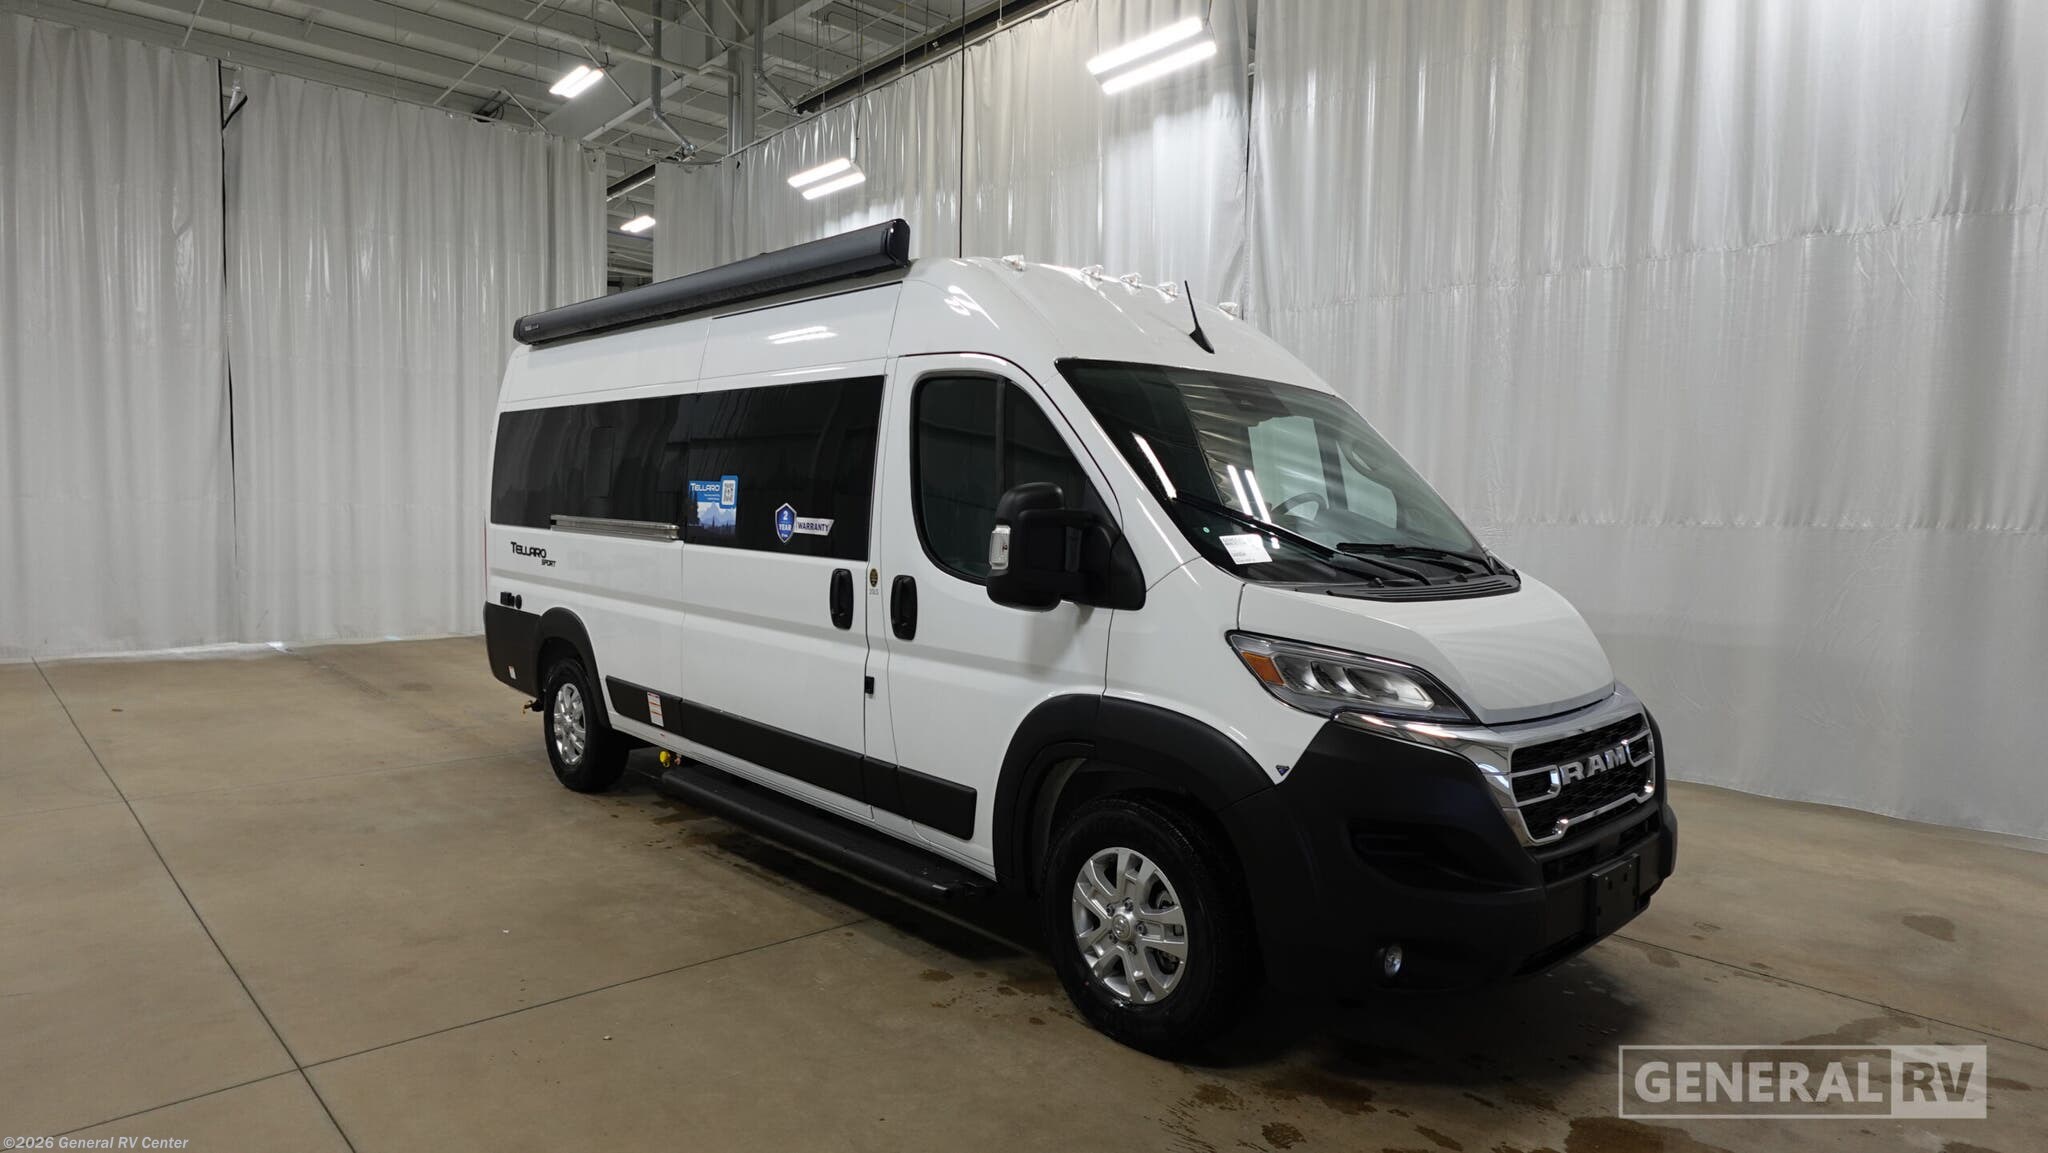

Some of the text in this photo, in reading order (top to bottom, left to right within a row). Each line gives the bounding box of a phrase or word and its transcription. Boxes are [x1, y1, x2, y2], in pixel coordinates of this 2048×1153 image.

[783, 510, 789, 521] 2
[797, 522, 830, 532] WARRANTY
[510, 541, 547, 559] TELLARO
[1559, 745, 1627, 786] RAM
